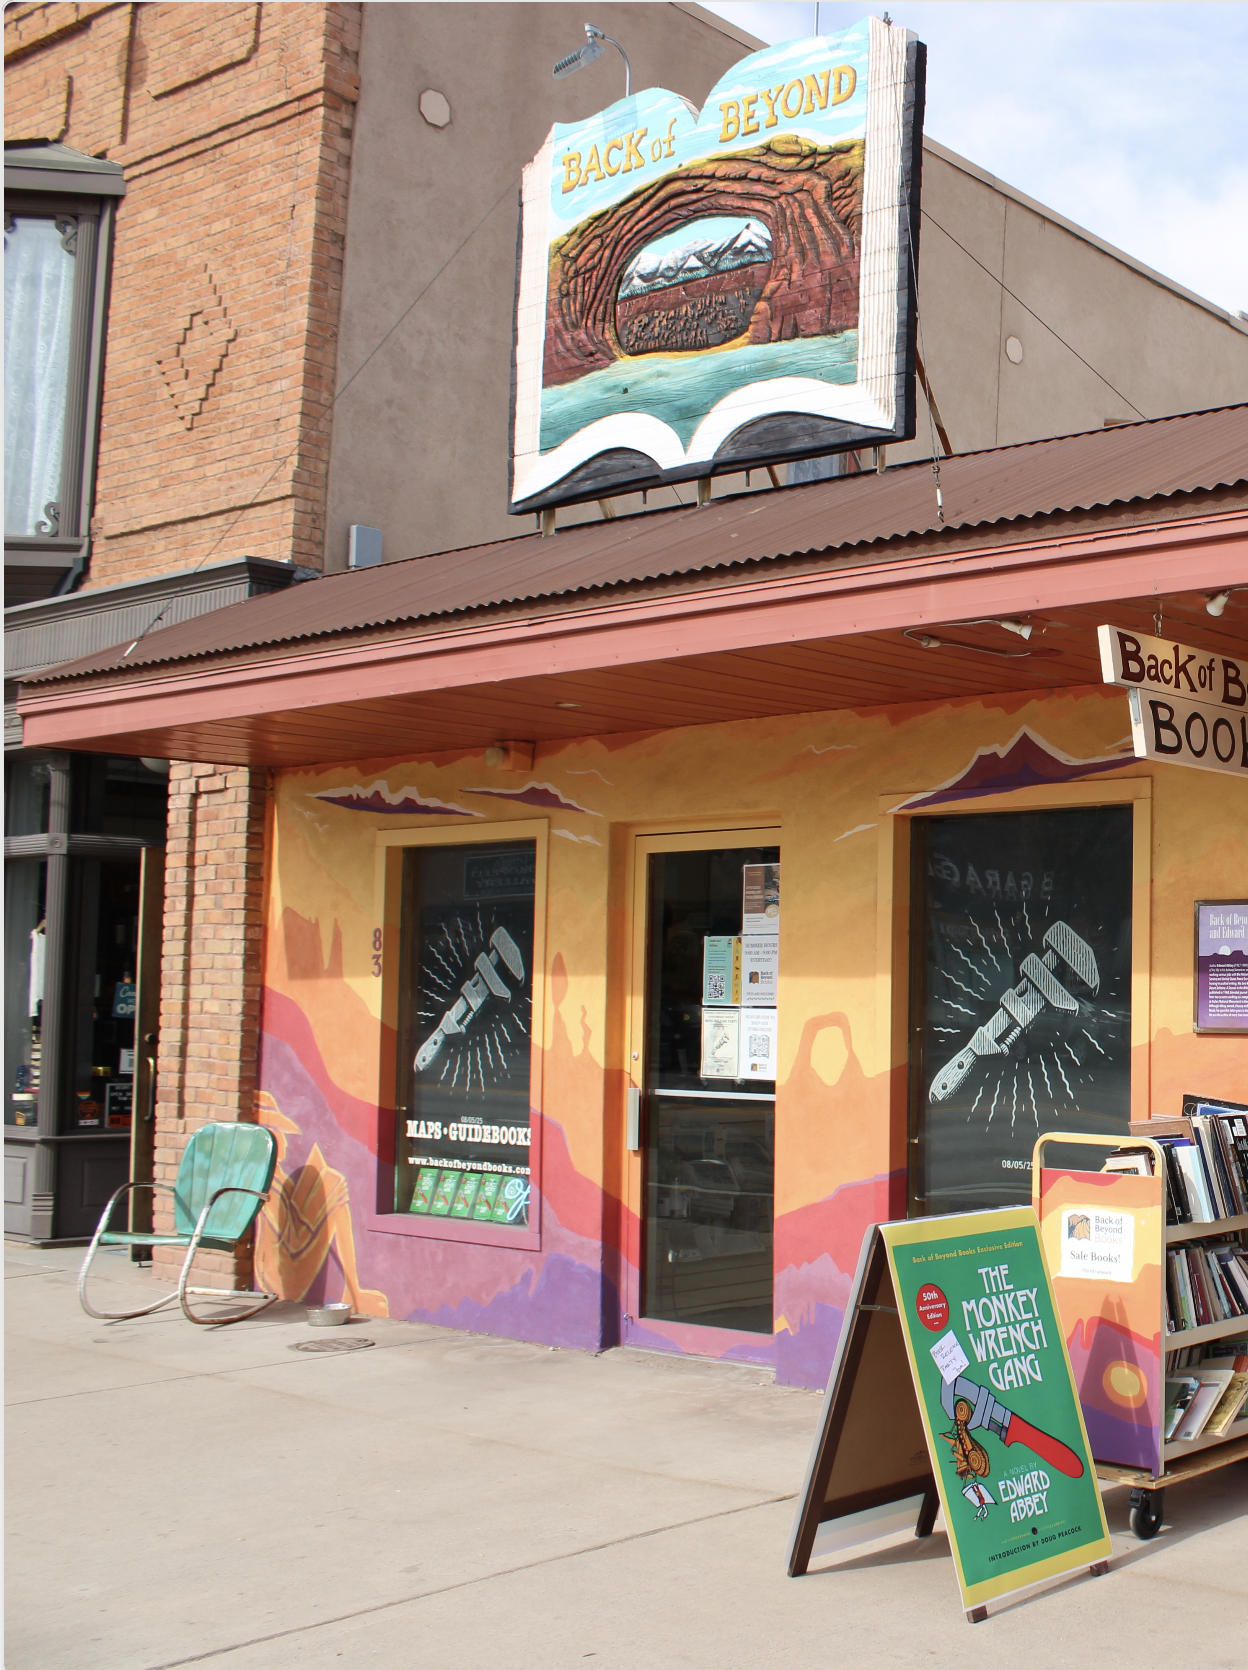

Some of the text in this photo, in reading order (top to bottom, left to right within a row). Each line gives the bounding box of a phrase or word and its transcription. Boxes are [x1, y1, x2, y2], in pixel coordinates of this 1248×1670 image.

[561, 64, 857, 194] BACK of BEYOND
[1116, 631, 1198, 693] Back
[1197, 658, 1215, 691] of
[1209, 913, 1224, 926] Back
[1226, 913, 1233, 926] of
[1209, 926, 1221, 939] and
[1222, 925, 1245, 939] Edward
[460, 1116, 484, 1125] 08/05/25
[1094, 1215, 1123, 1226] Back of
[1094, 1224, 1123, 1235] Beyond
[1094, 1233, 1123, 1245] Books
[912, 1240, 1024, 1263] Back of Beyond Books Exclusive Edition
[1070, 1249, 1121, 1264] Sale Books!
[977, 1263, 1014, 1294] THE
[922, 1290, 939, 1301] 50th
[919, 1302, 946, 1312] Anniversary
[961, 1287, 1039, 1332] MONKEY
[926, 1312, 942, 1320] Edition
[968, 1318, 1048, 1364] WRENCH
[988, 1353, 1043, 1391] GANG
[1009, 1464, 1029, 1476] NOVEL
[1029, 1461, 1037, 1470] BY
[998, 1469, 1050, 1502] EDWARD
[1010, 1490, 1048, 1523] ABBEY
[988, 1543, 1031, 1563] INTRODUCTION
[1032, 1540, 1040, 1548] BY
[1041, 1534, 1057, 1545] DOUG
[1058, 1525, 1082, 1539] PEACOCK
